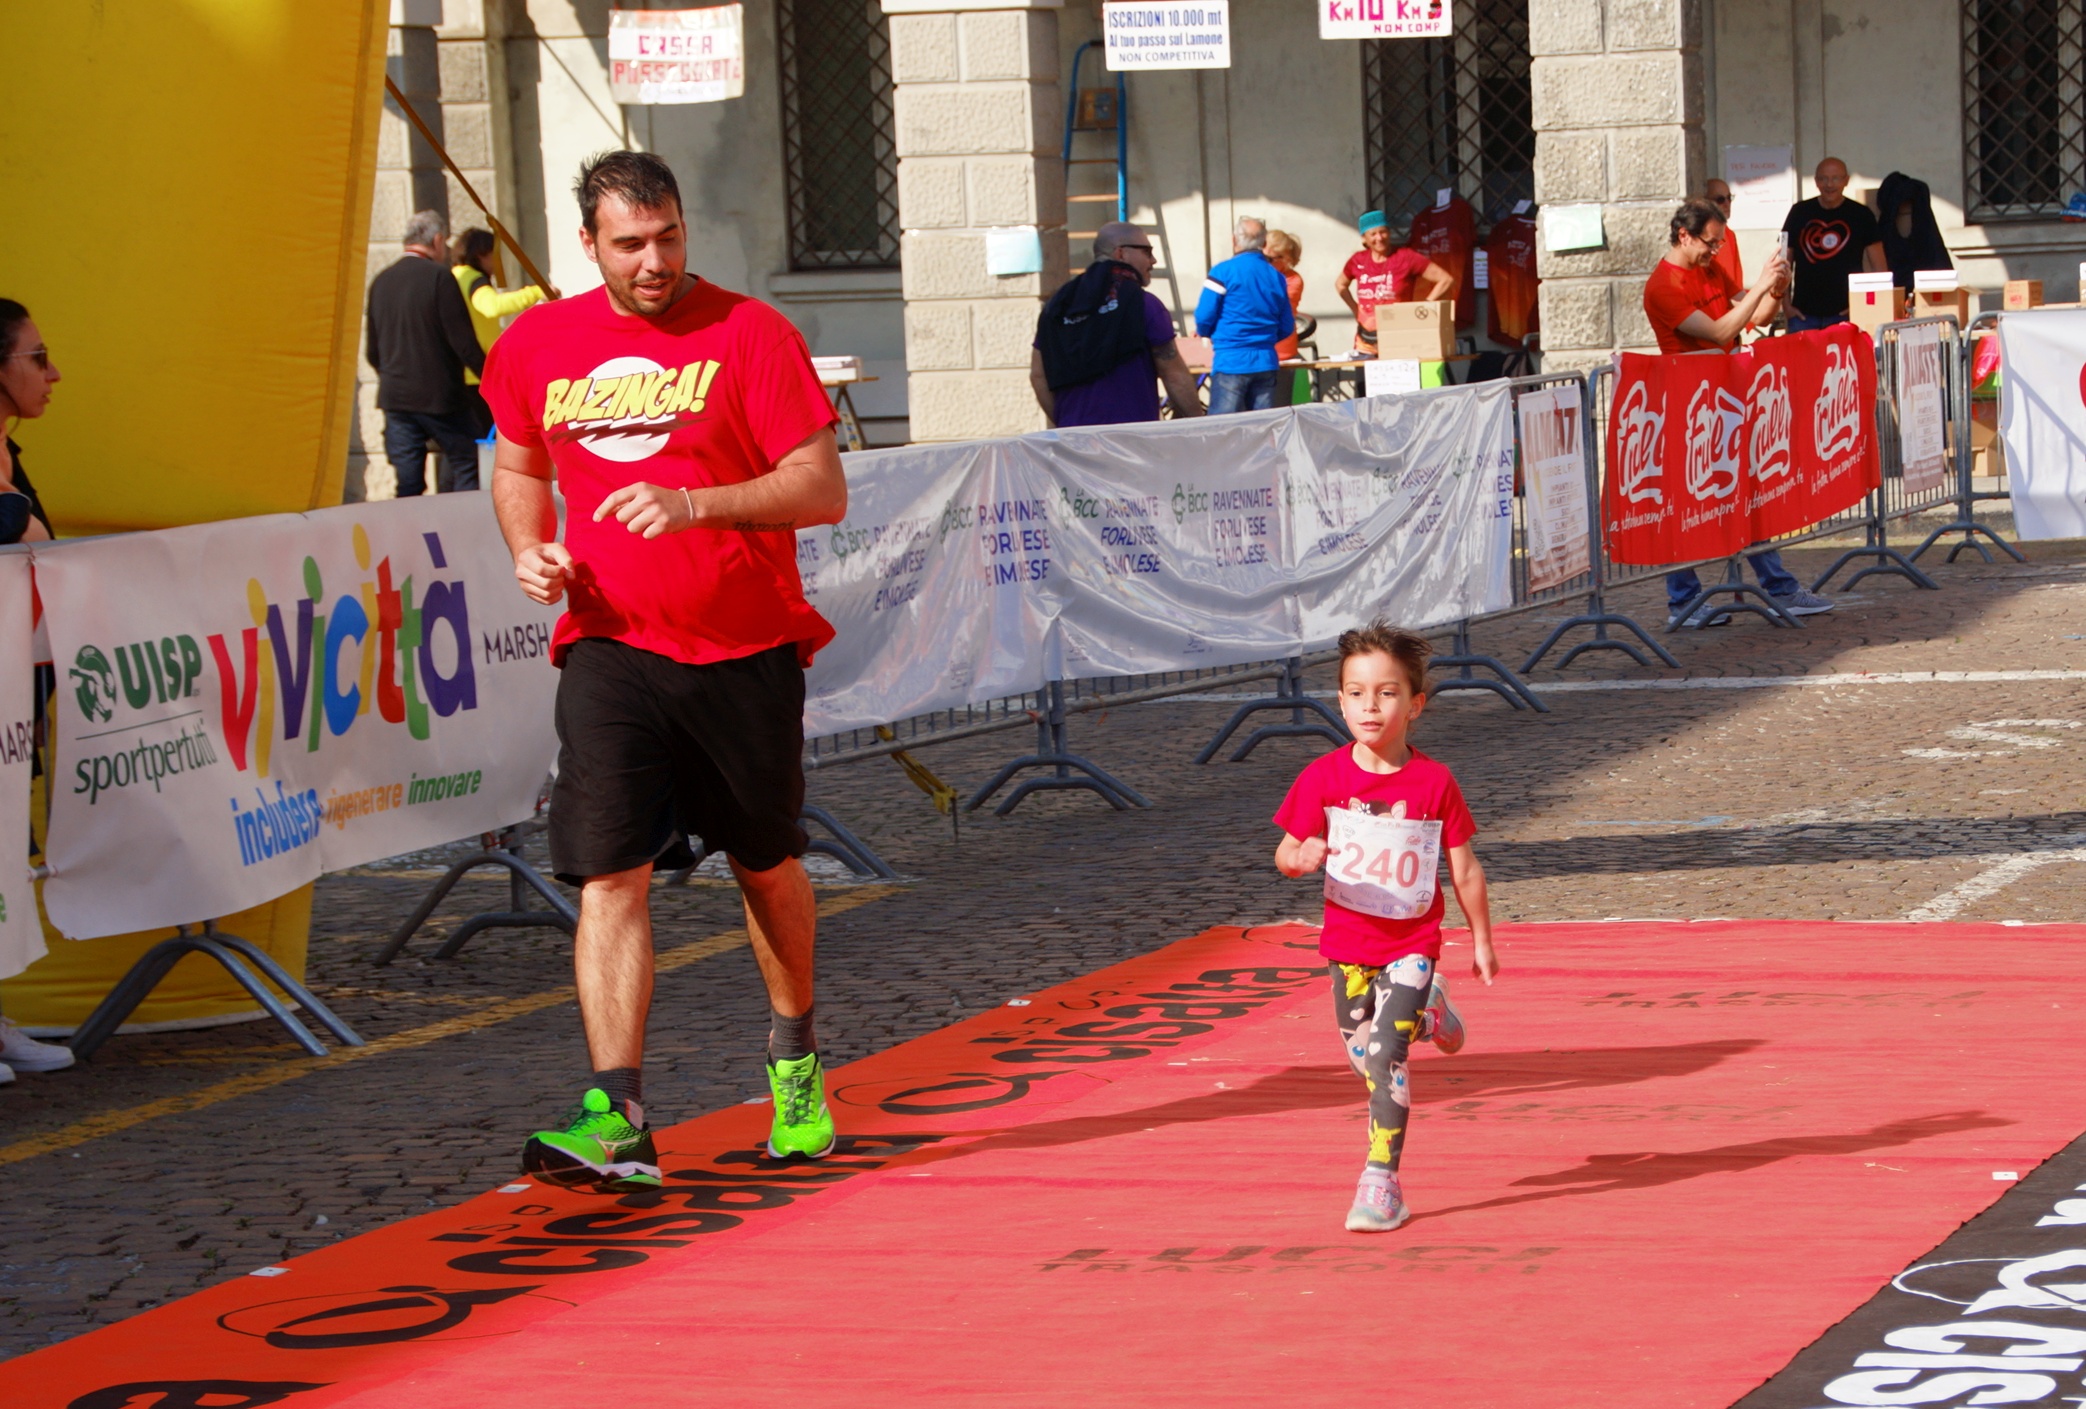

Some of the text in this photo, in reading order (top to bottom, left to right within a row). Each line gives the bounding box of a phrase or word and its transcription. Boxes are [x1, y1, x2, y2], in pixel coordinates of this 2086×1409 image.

[1108, 9, 1222, 28] ISCRIZIONI 10.000 mt
[1374, 22, 1440, 33] NON COMP
[639, 35, 712, 55] CASSA
[1110, 32, 1223, 48] Al tuo passo sul Lamone
[1119, 51, 1215, 62] NON COMPETITIVA
[543, 359, 721, 431] BAZINGA!
[1073, 498, 1099, 518] BCC
[1188, 488, 1272, 513] BCC RAVENNATE
[952, 506, 973, 530] BCC
[848, 528, 871, 554] BCC
[207, 523, 477, 779] vivicittà
[483, 621, 550, 665] MARSH
[114, 634, 202, 710] UISP
[407, 769, 482, 805] innovare
[324, 782, 403, 831] rigenerare
[1341, 842, 1420, 888] 240
[1046, 1245, 1562, 1264] LUCCI
[1032, 1263, 1544, 1275] TRASPORTI
